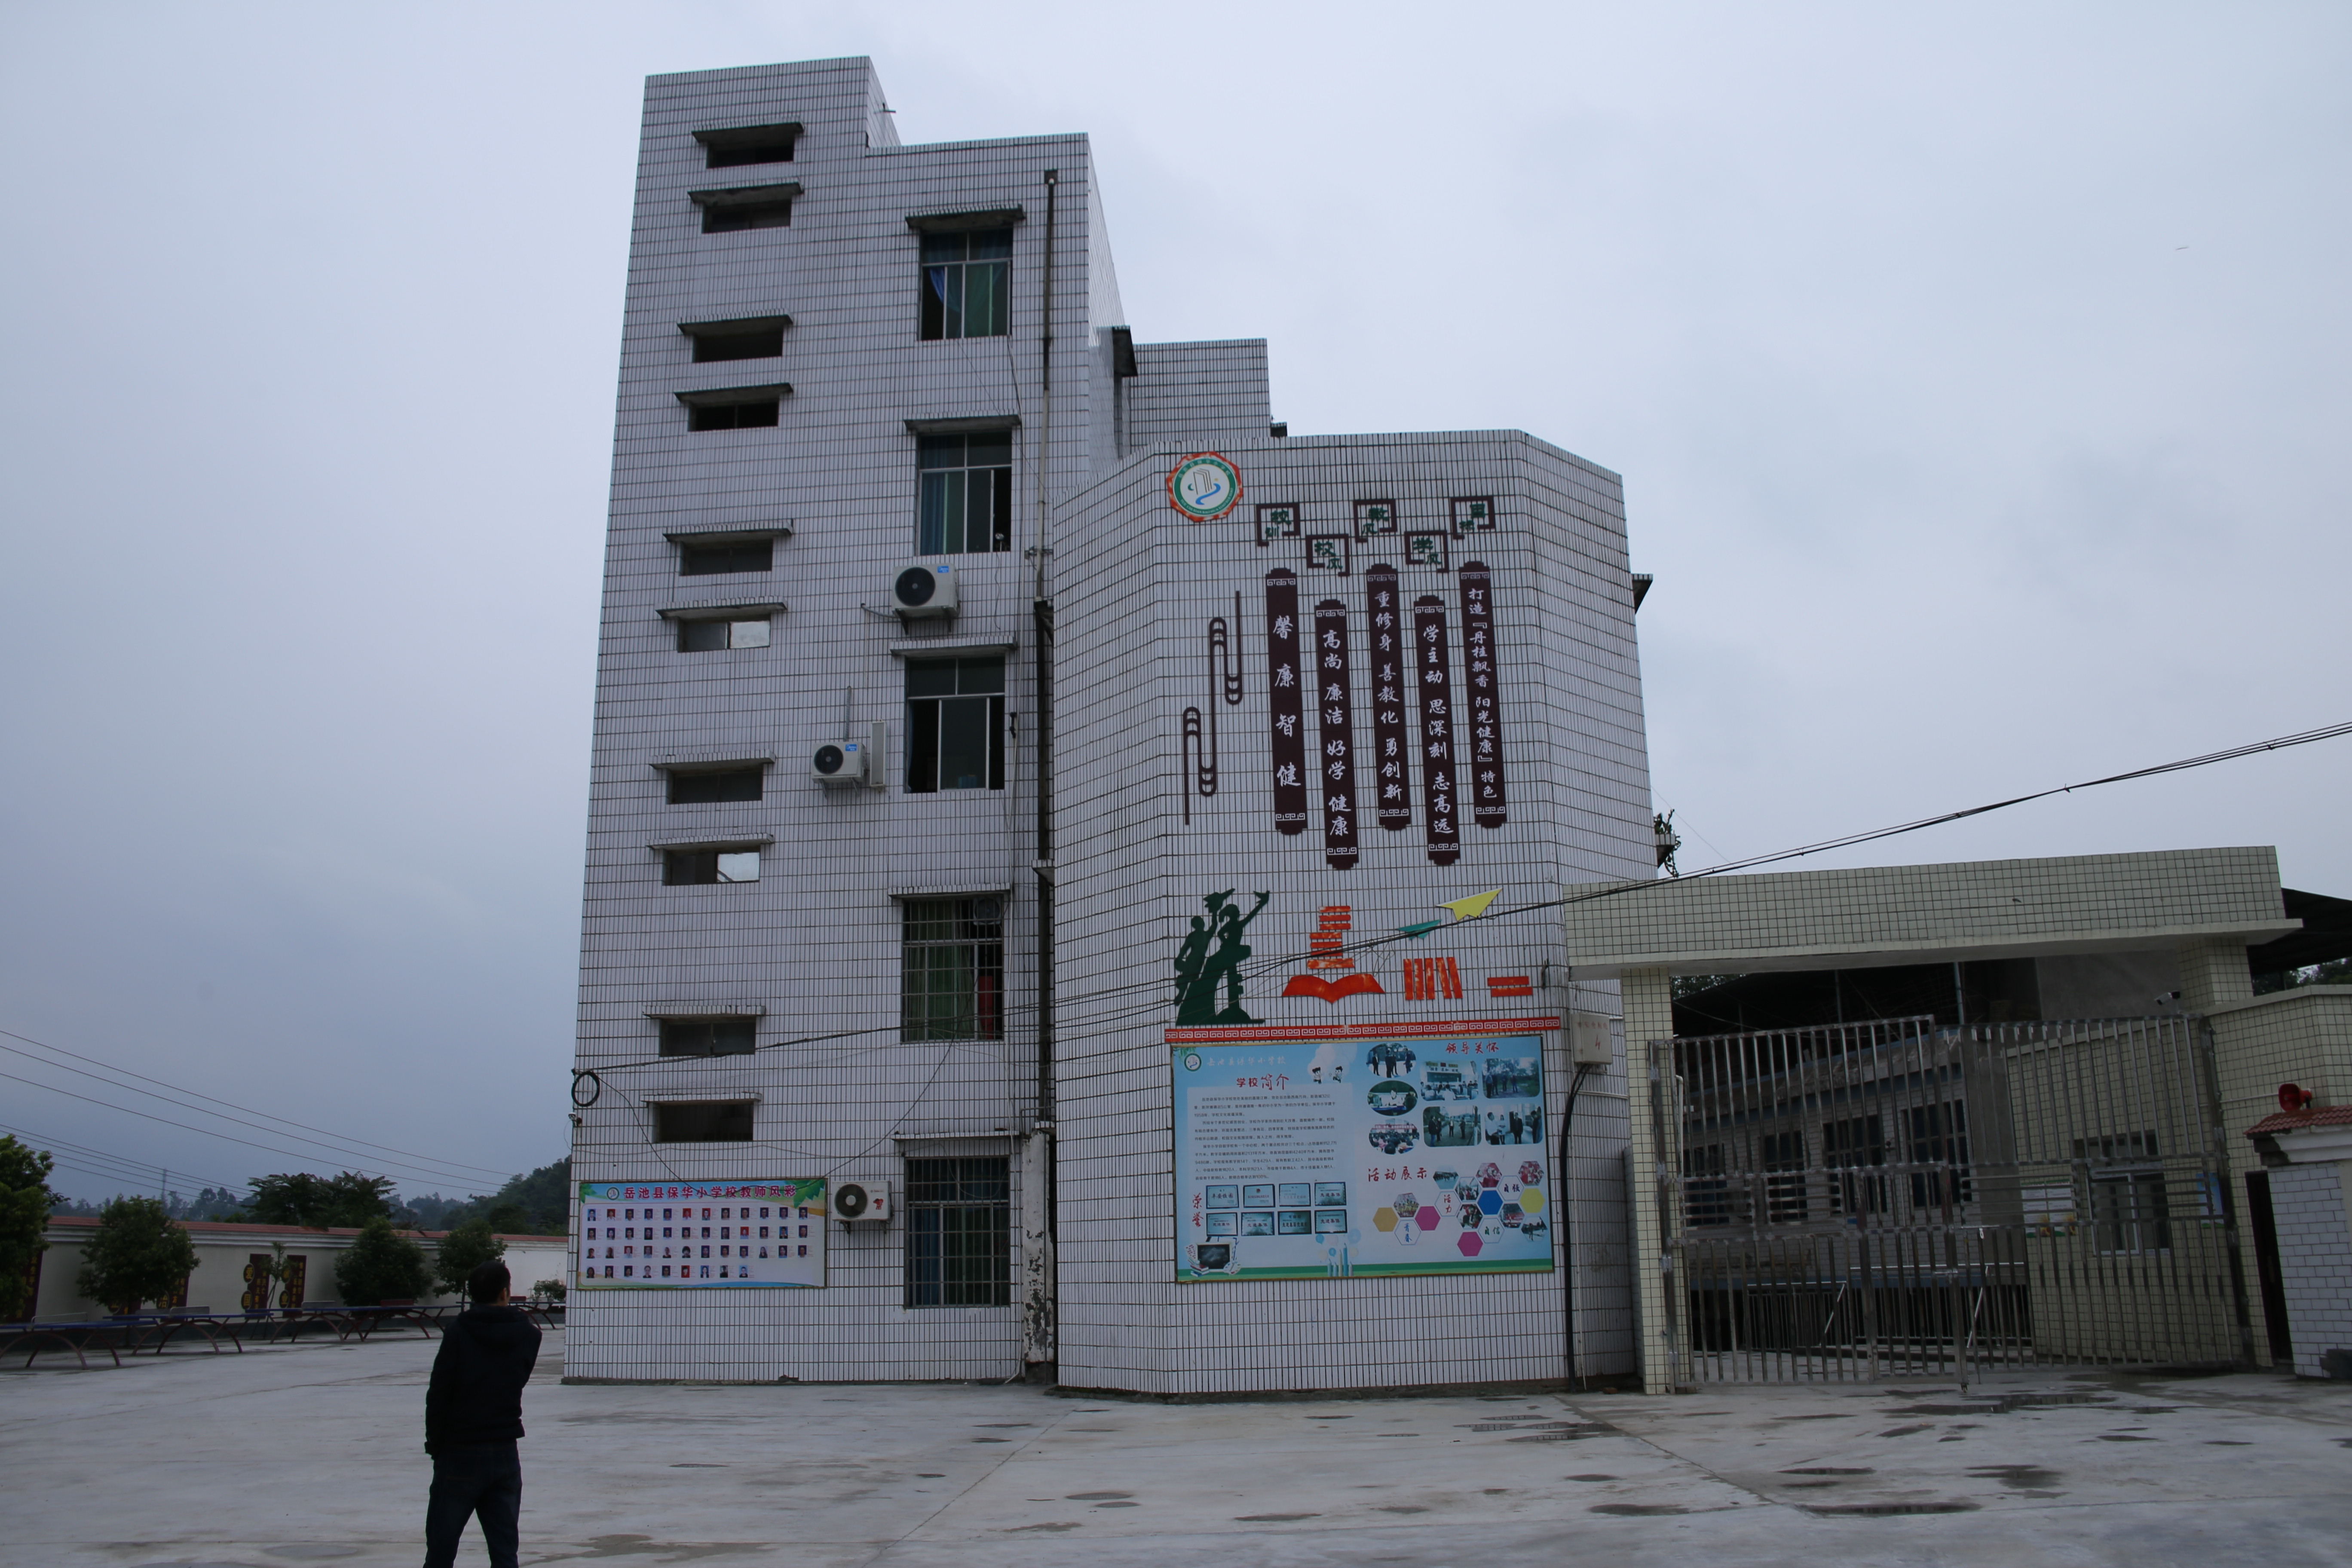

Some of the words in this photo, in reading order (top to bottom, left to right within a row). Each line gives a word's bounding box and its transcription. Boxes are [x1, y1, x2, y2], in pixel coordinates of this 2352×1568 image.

[1265, 510, 1291, 538] 校训
[1362, 507, 1390, 535] 教风
[1314, 541, 1343, 570] 校风
[1412, 537, 1442, 566] 学风
[1273, 616, 1301, 787] 馨廉智健
[1446, 1041, 1499, 1054] 领导关怀
[1236, 1073, 1289, 1091] 学校简介
[1368, 1166, 1427, 1182] 活动展示
[624, 1185, 798, 1200] 岳池县保华小学校教师风彩
[1504, 1183, 1520, 1193] 自强
[1192, 1192, 1204, 1227] 荣誉
[1444, 1194, 1452, 1214] 活力
[1404, 1222, 1412, 1243] 青春
[1484, 1226, 1501, 1236] 自信
